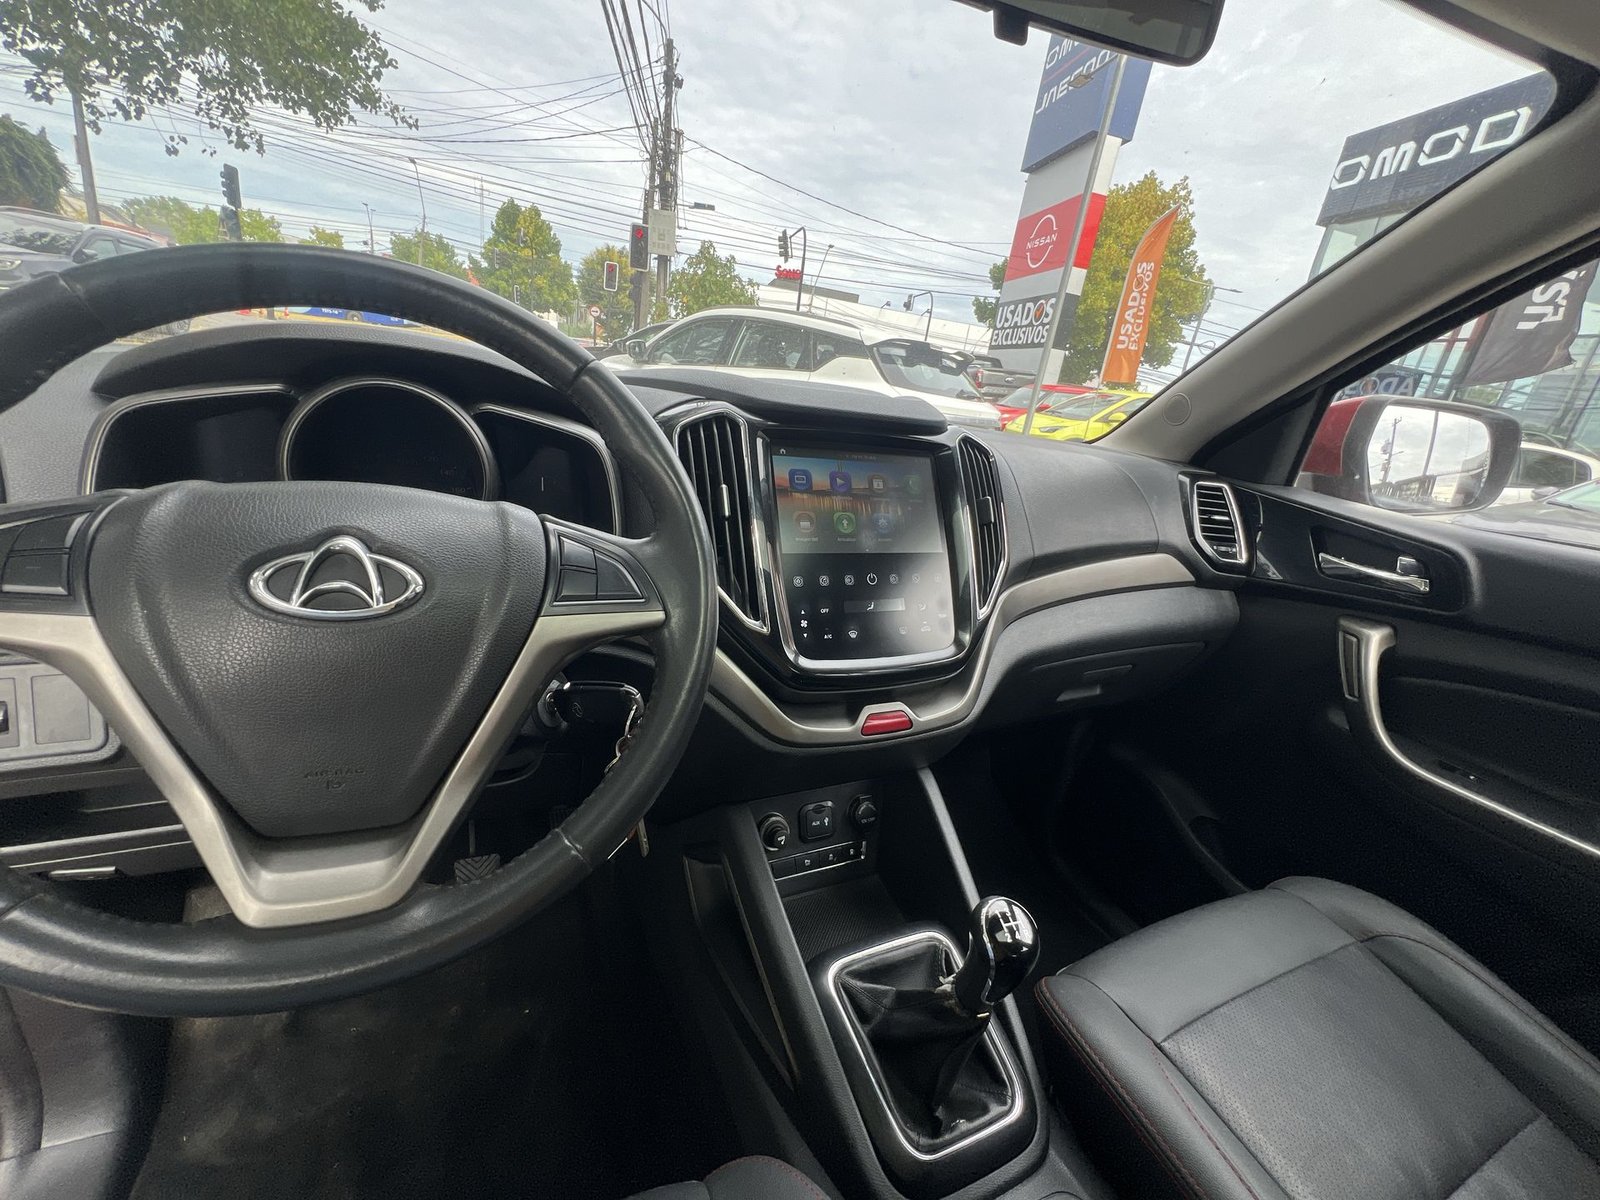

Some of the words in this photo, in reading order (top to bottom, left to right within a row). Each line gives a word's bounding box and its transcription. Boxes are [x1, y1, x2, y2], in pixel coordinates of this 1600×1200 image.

[1026, 233, 1058, 250] NISSAN
[995, 297, 1057, 329] USADOS
[1116, 261, 1147, 350] USADOS
[1127, 261, 1155, 351] EXCLUSIVOS
[990, 325, 1050, 346] EXCLUSIVOS
